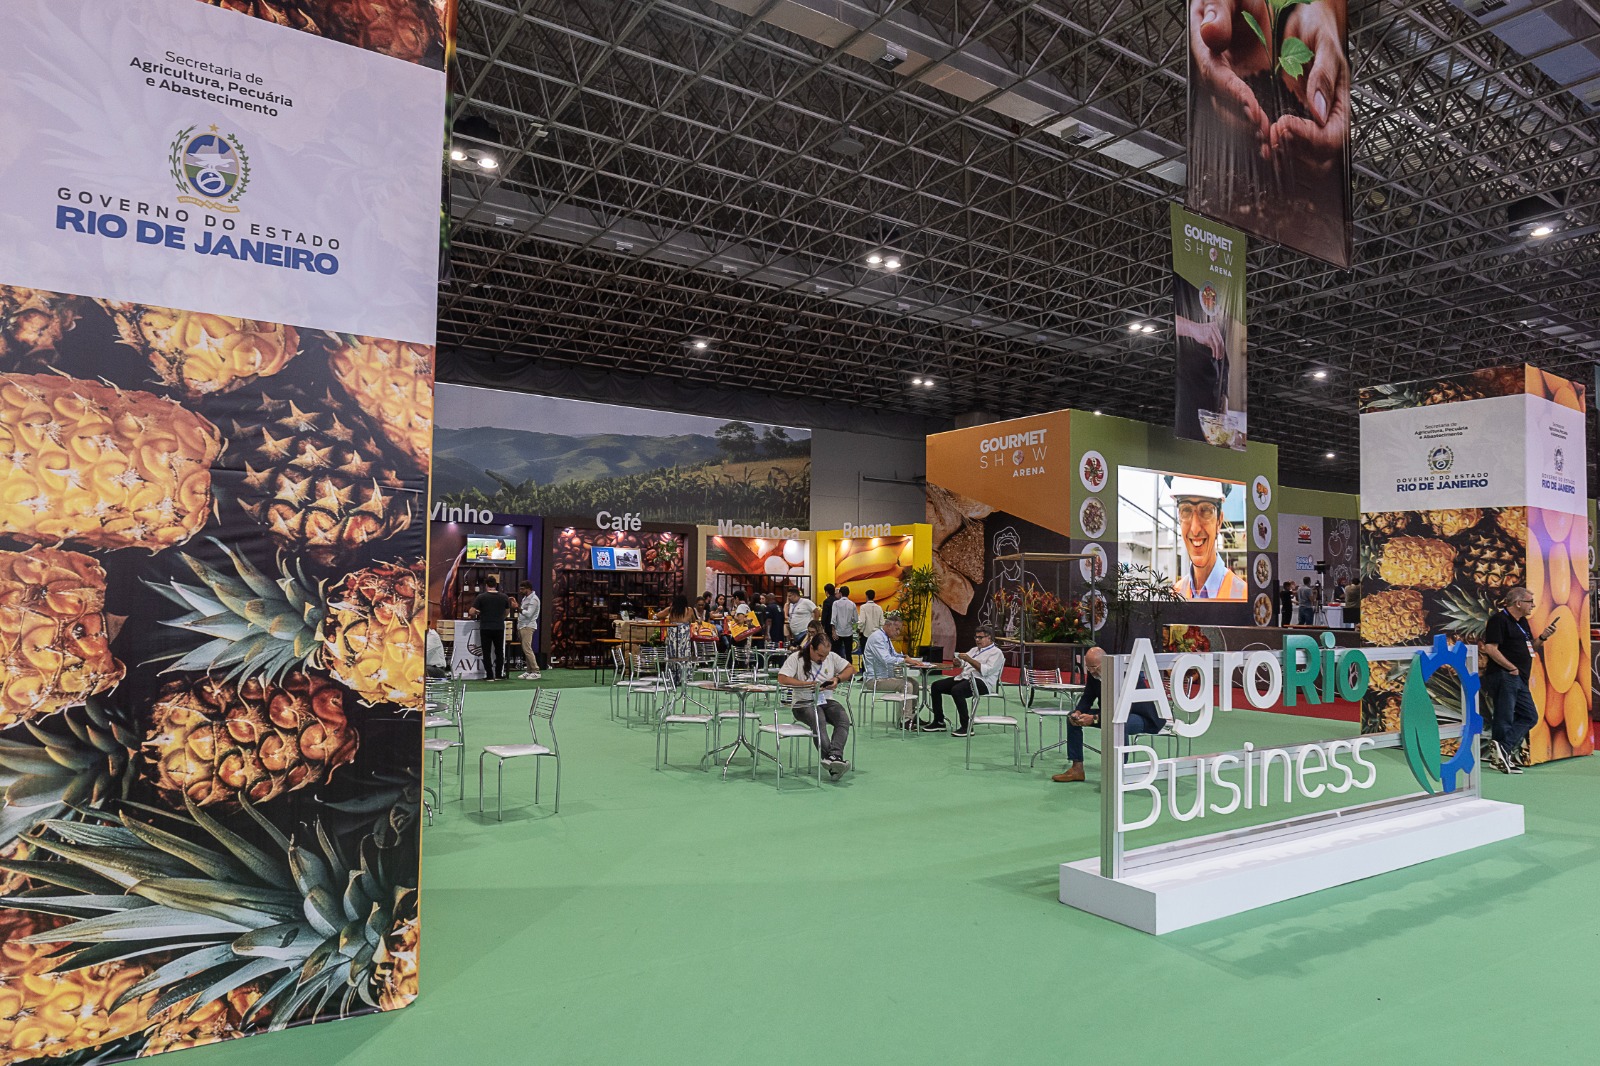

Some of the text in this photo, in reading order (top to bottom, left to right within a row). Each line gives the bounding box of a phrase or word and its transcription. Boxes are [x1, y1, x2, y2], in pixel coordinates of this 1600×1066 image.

[165, 51, 264, 86] Secretaria de
[129, 57, 294, 108] Agricultura, Pecuária
[145, 77, 279, 117] e Abastecimento
[57, 187, 190, 223] GOVERNO
[205, 215, 236, 231] DO
[250, 223, 341, 251] ESTADO
[56, 205, 340, 276] RIO DE JANEIRO
[1184, 223, 1233, 252] GOURMET
[1209, 264, 1233, 278] ARENA
[980, 428, 1048, 454] GOURMET
[1012, 466, 1046, 478] ARENA
[1396, 476, 1436, 484] GOVERNO
[1454, 472, 1489, 480] ESTADO
[1396, 479, 1489, 493] RIO DE JANEIRO
[1541, 479, 1576, 495] RIO DE JANEIRO
[430, 501, 494, 525] Vinho
[596, 510, 642, 531] Café
[718, 518, 800, 540] Mandioca
[843, 521, 892, 539] Banana
[1112, 632, 1370, 738] AgroRio
[1115, 737, 1377, 832] Business
